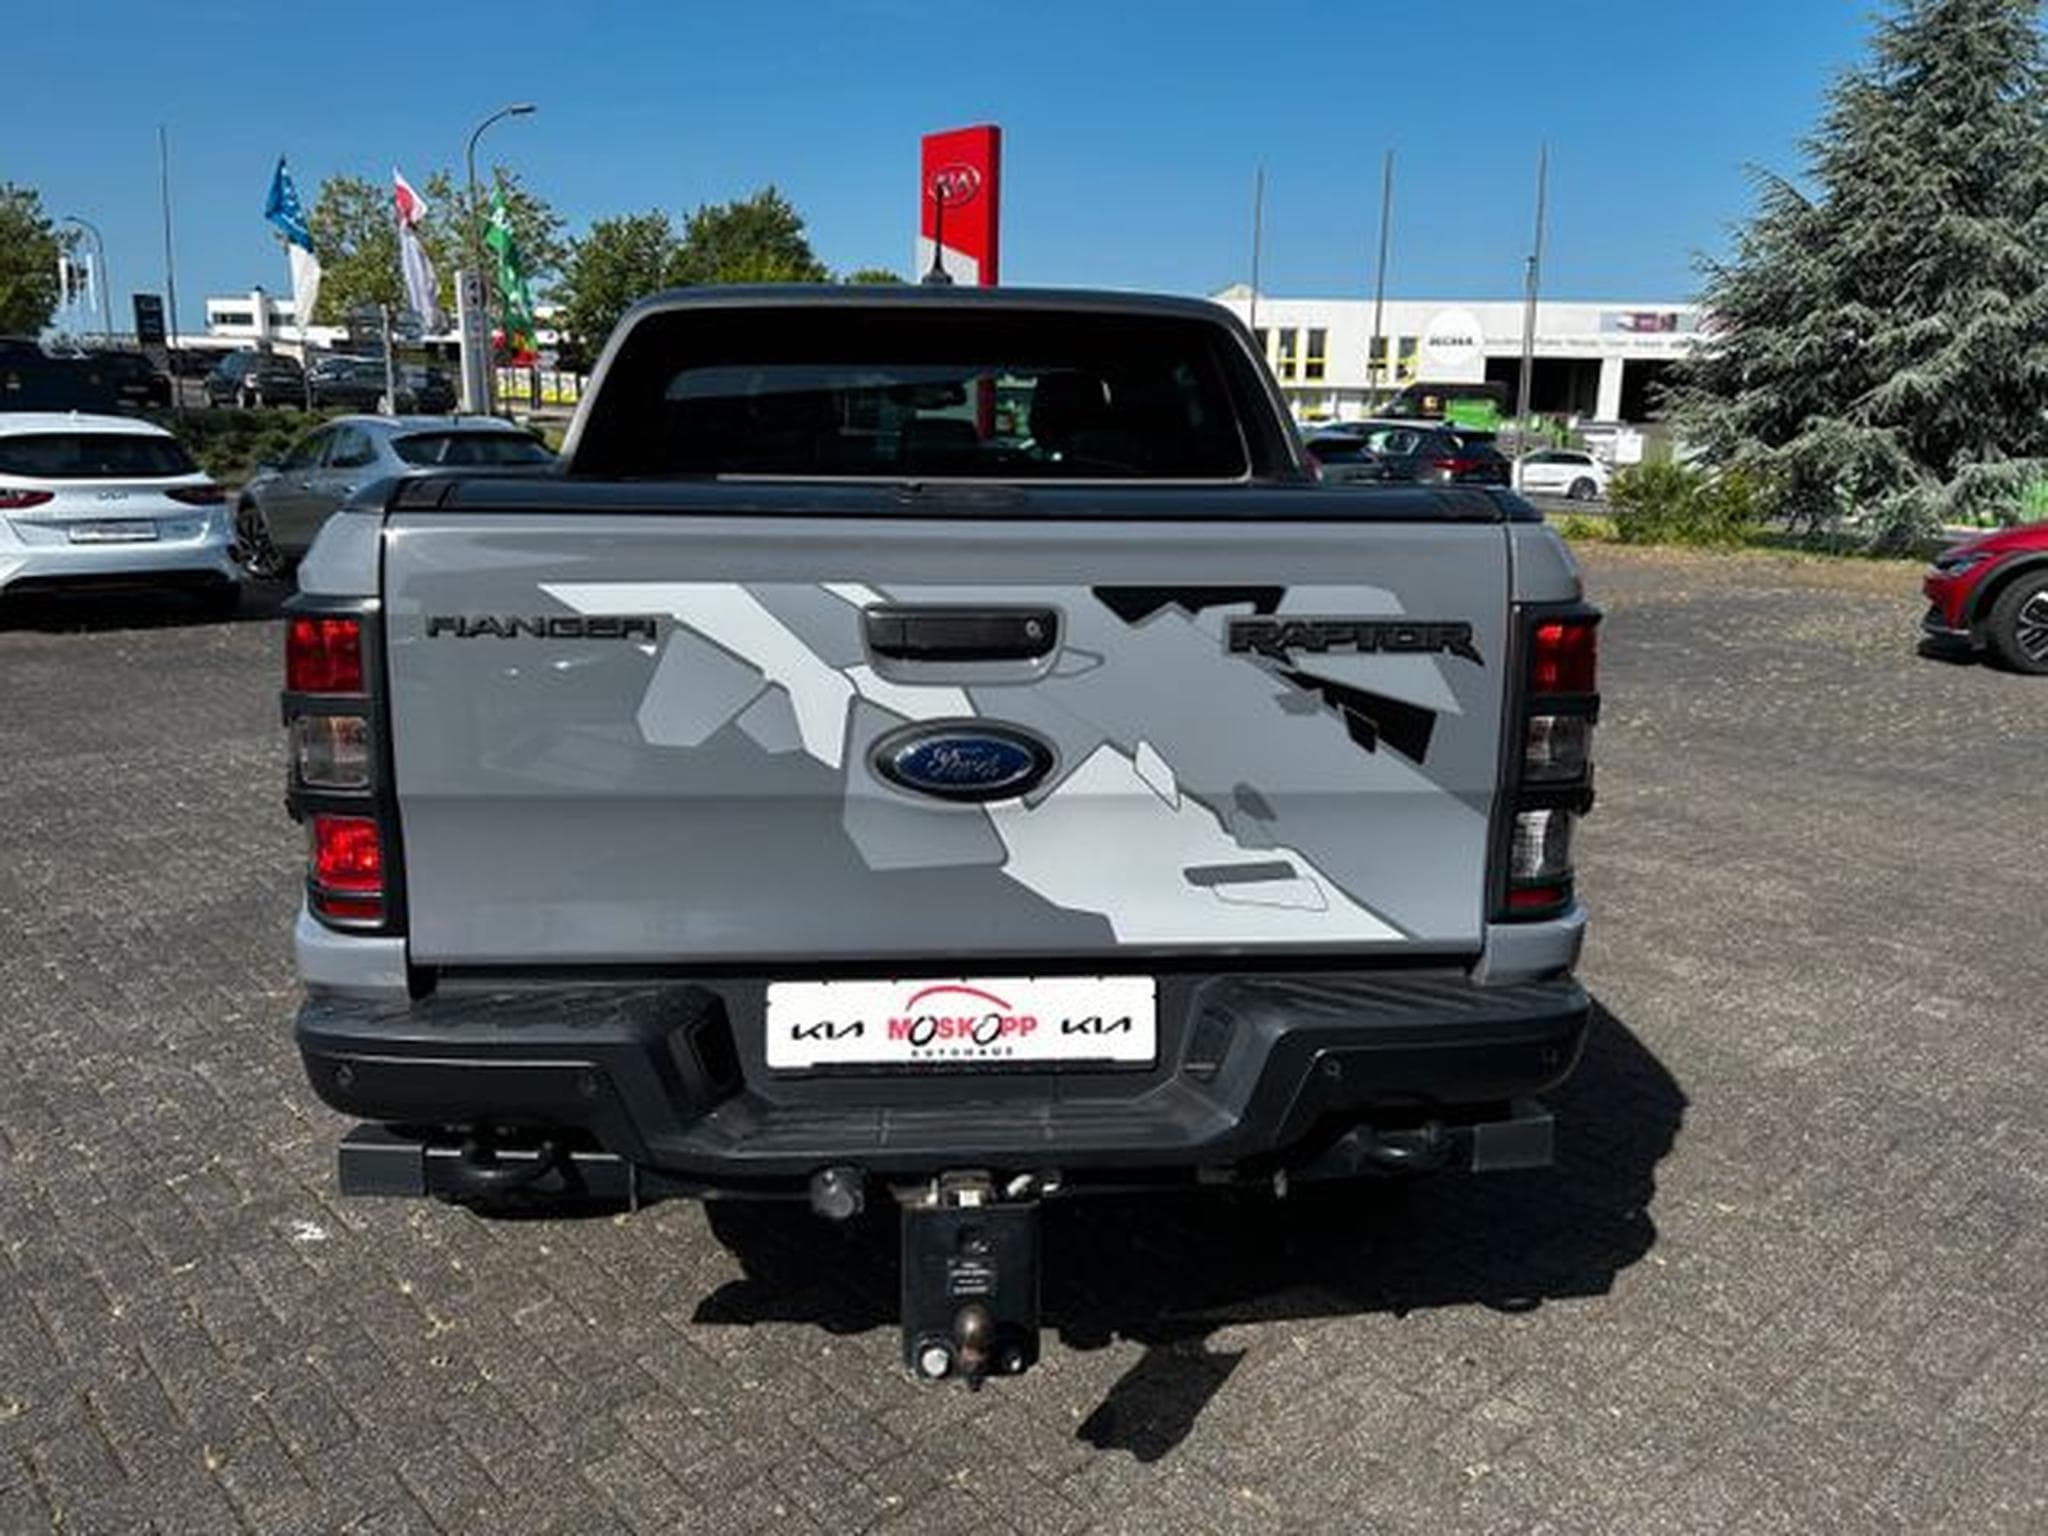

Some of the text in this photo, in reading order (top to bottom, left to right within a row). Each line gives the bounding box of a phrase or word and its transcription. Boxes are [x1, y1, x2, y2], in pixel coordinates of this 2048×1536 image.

[426, 615, 657, 640] RANGER
[1229, 620, 1485, 667] RAPTOR
[926, 747, 1001, 778] Ford
[791, 1020, 864, 1041] KIA
[887, 1013, 1037, 1046] MOSKOPP
[1061, 1015, 1133, 1036] KIA
